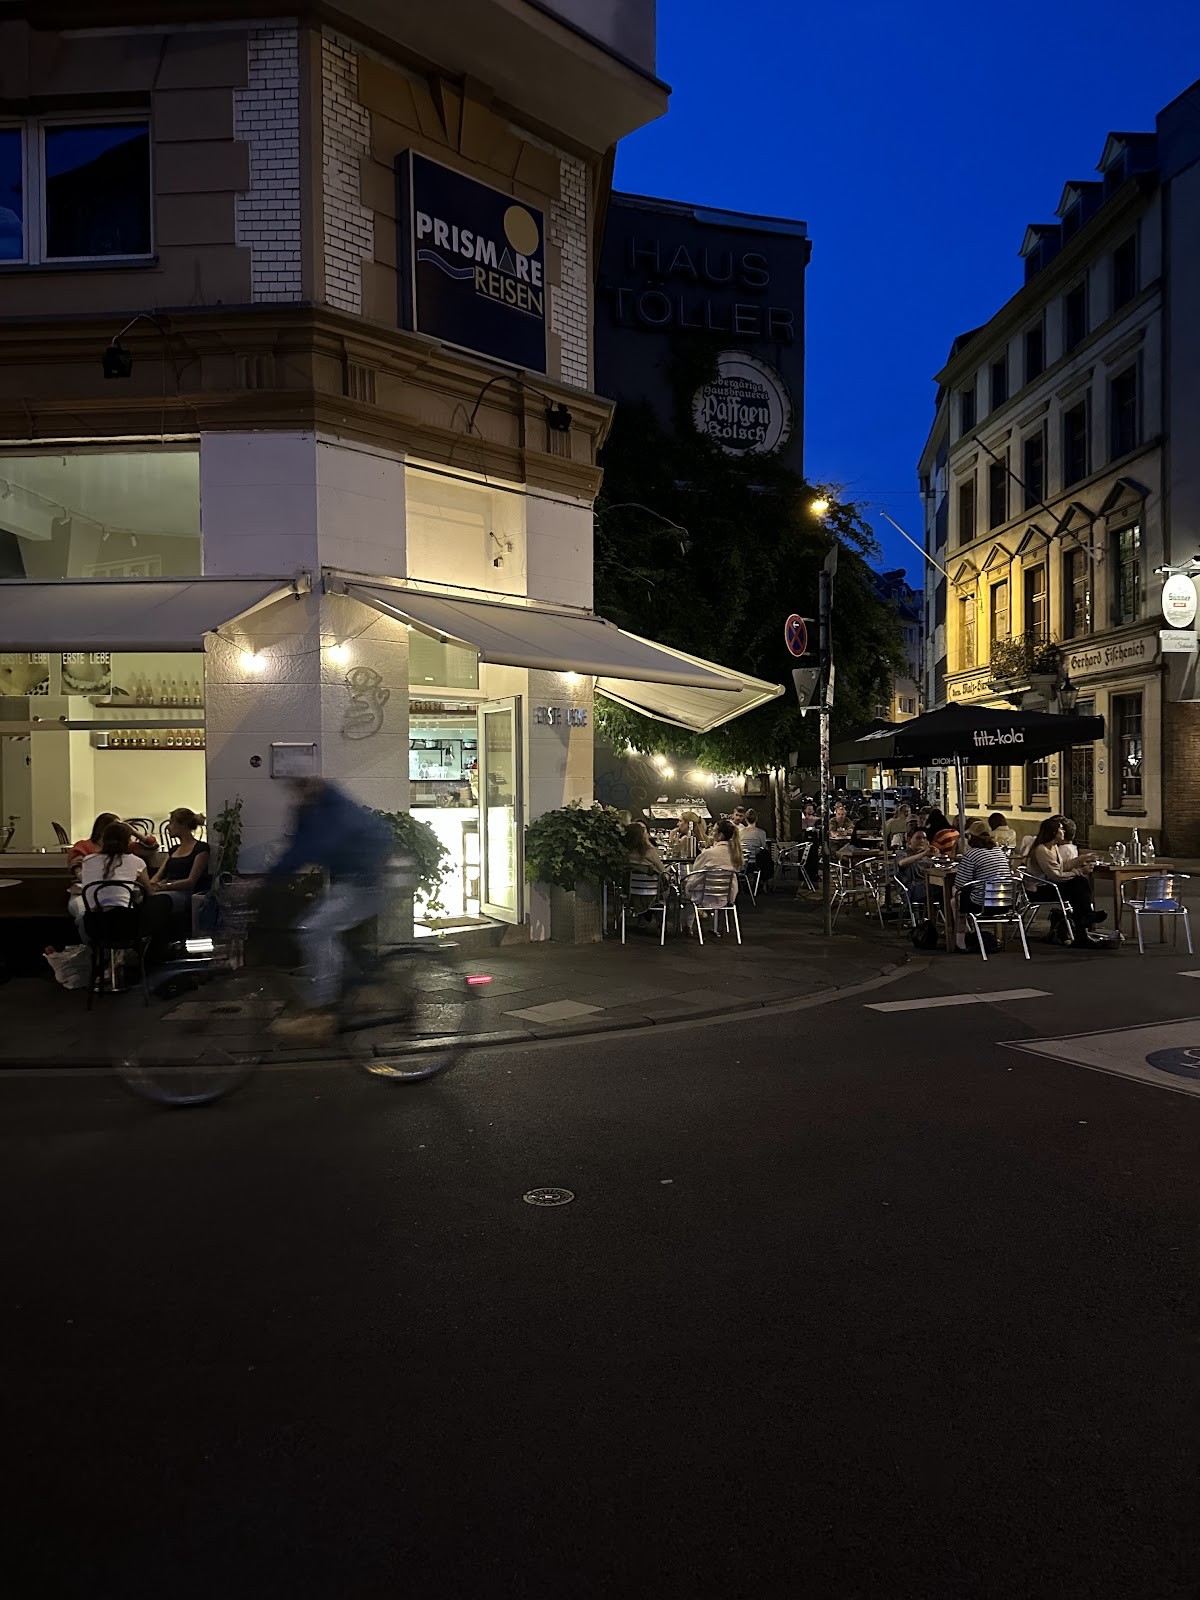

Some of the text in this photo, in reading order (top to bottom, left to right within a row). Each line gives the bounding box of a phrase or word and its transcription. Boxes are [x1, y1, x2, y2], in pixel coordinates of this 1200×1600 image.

[416, 210, 544, 288] PRISMARE
[630, 232, 770, 288] HAUS
[475, 265, 544, 316] REISEN
[616, 280, 796, 341] TÖLLER
[702, 395, 770, 427] Päffgen
[707, 421, 767, 445] Kölsch
[62, 652, 111, 665] ERSTE LIEBE
[1070, 651, 1102, 672] Gerhard
[973, 727, 1025, 747] fritz-kola
